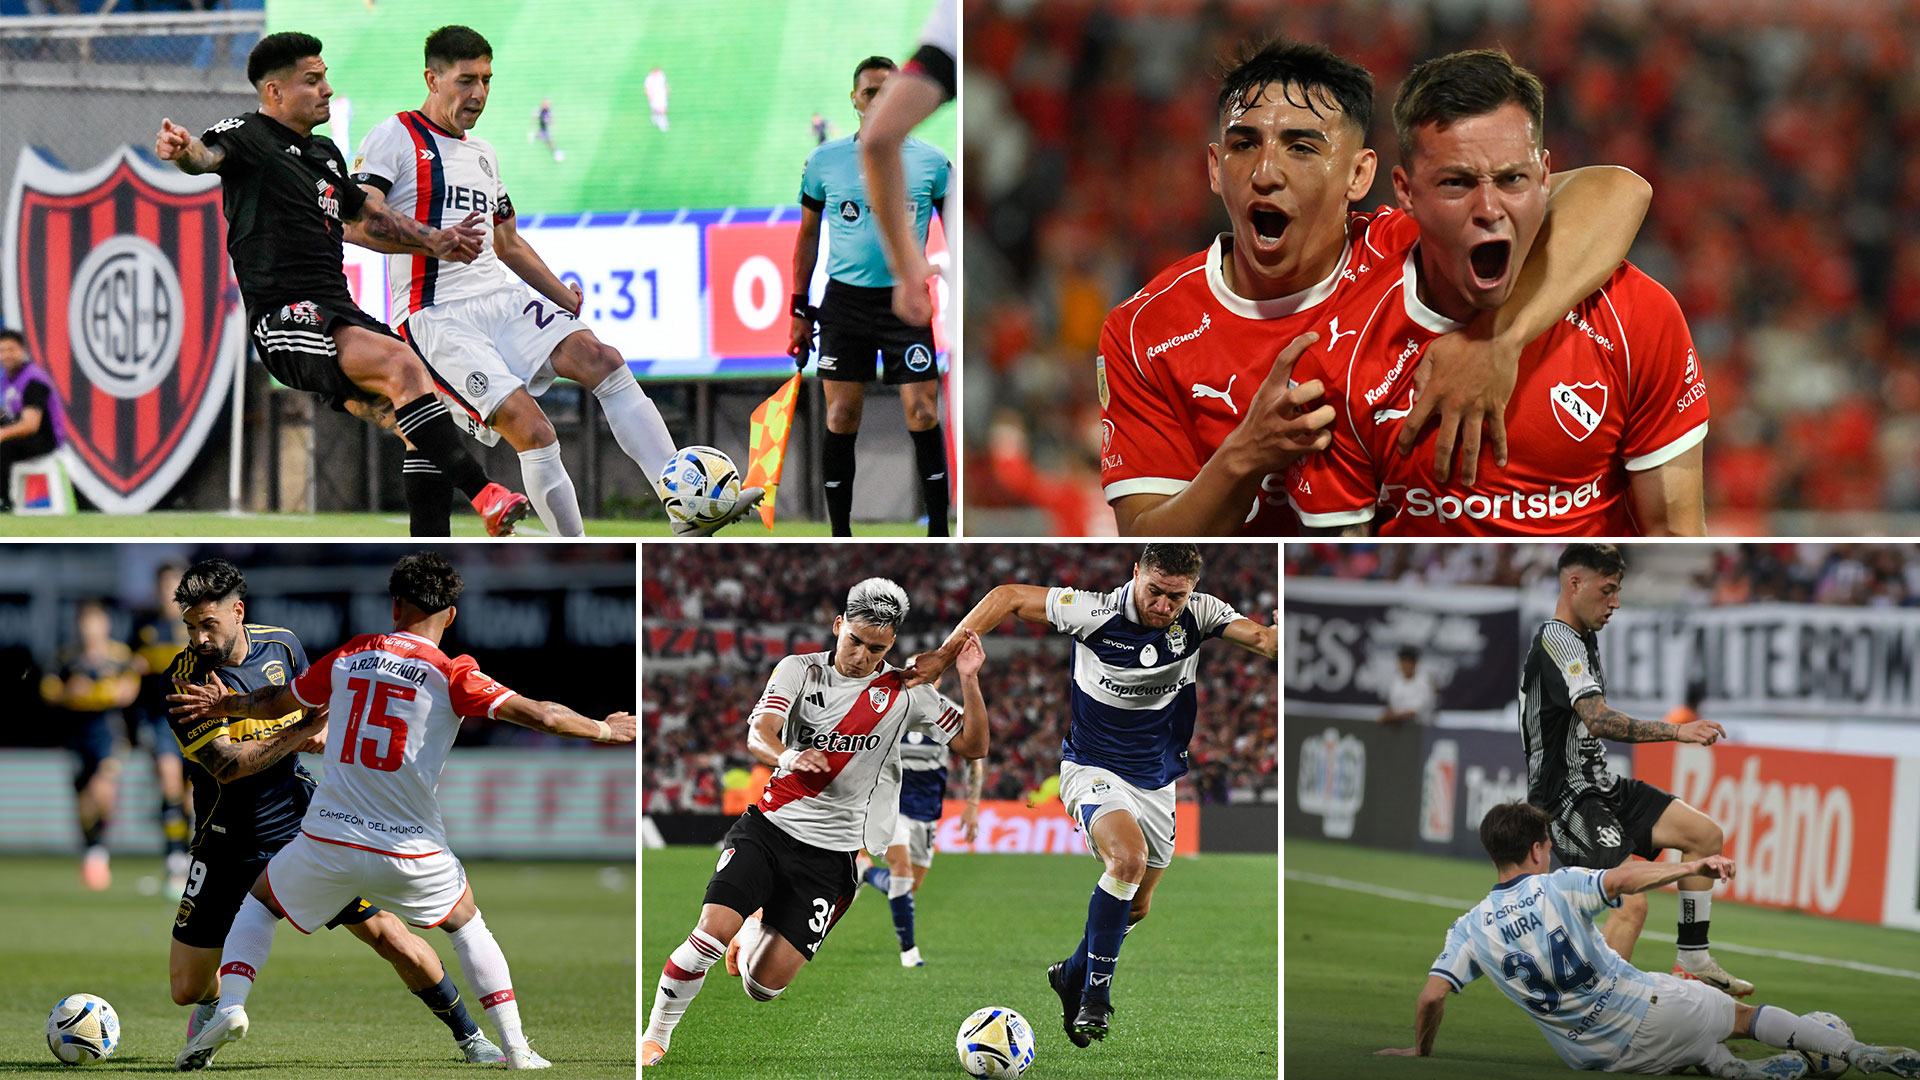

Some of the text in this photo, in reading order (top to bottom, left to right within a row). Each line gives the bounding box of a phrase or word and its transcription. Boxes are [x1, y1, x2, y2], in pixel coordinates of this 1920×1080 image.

[733, 256, 784, 330] 0
[349, 656, 428, 687] ARZAMENDIA
[340, 677, 417, 772] 15
[797, 724, 881, 753] Betano
[319, 808, 424, 834] CAMPEÓN DEL MUNDO
[186, 860, 208, 898] 9
[1501, 911, 1543, 945] MURA
[1501, 925, 1600, 1016] 34
